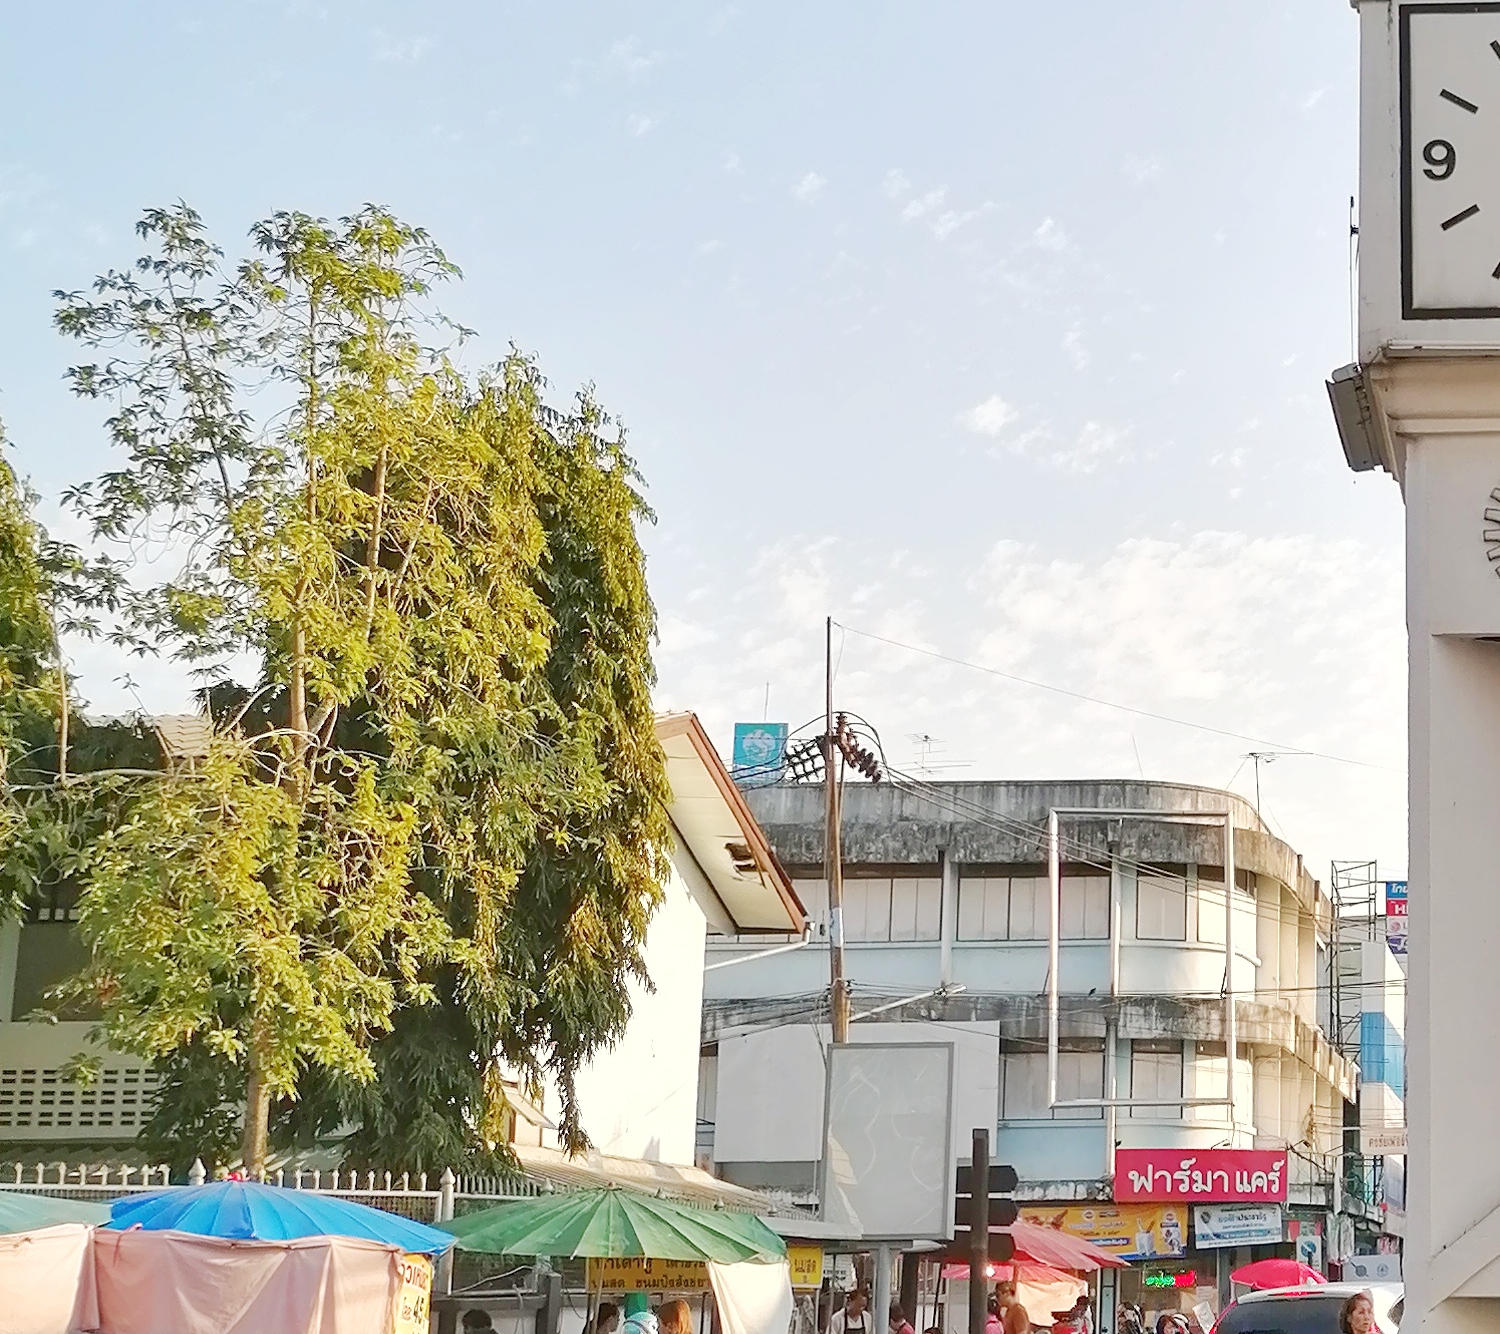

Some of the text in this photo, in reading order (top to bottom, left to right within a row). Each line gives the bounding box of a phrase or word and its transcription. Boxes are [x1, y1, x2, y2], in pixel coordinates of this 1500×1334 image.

[1422, 139, 1456, 180] 9
[1128, 1158, 1285, 1193] ฟาร์มา แคร์
